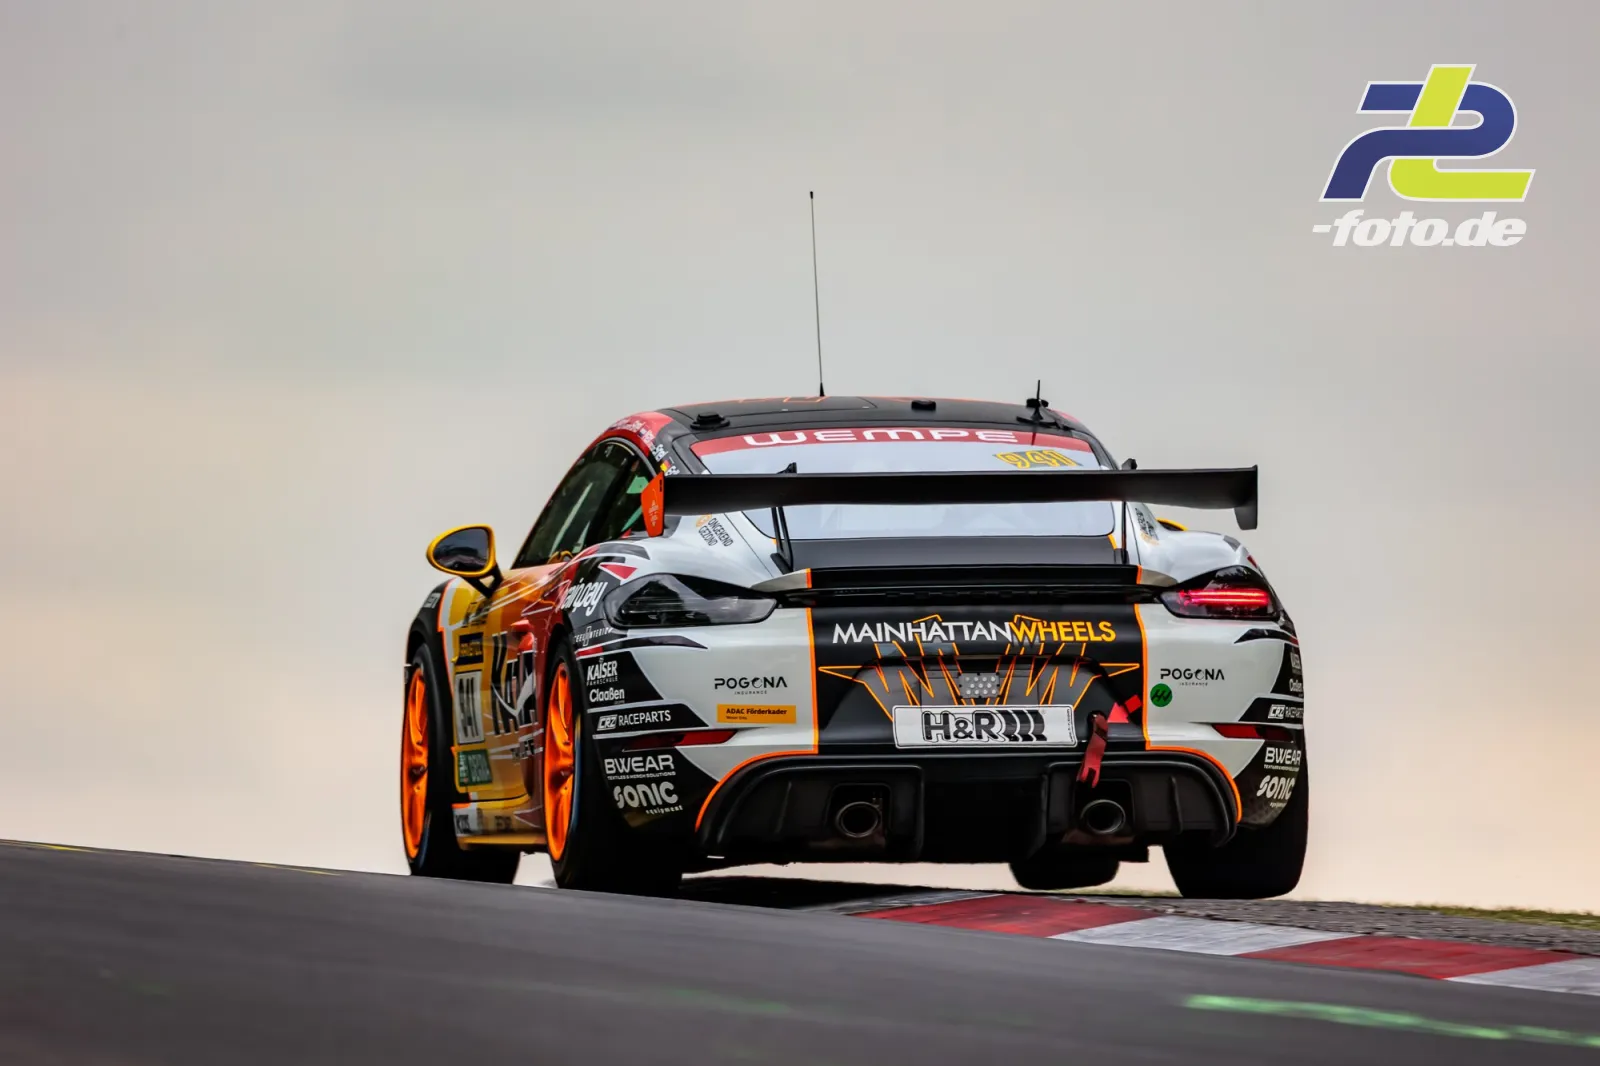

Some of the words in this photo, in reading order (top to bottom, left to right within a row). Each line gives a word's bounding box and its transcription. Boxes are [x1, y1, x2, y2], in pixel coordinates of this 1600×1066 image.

[743, 429, 1018, 446] WEMPE
[995, 450, 1079, 469] 941
[587, 660, 618, 682] KAISER
[1160, 667, 1225, 681] POGONA
[714, 676, 788, 690] POGONA
[618, 710, 672, 726] RACEPARTS
[746, 707, 788, 715] Förderkader
[922, 710, 1006, 743] H&R
[604, 754, 675, 774] BWEAR
[1264, 746, 1301, 766] BWEAR
